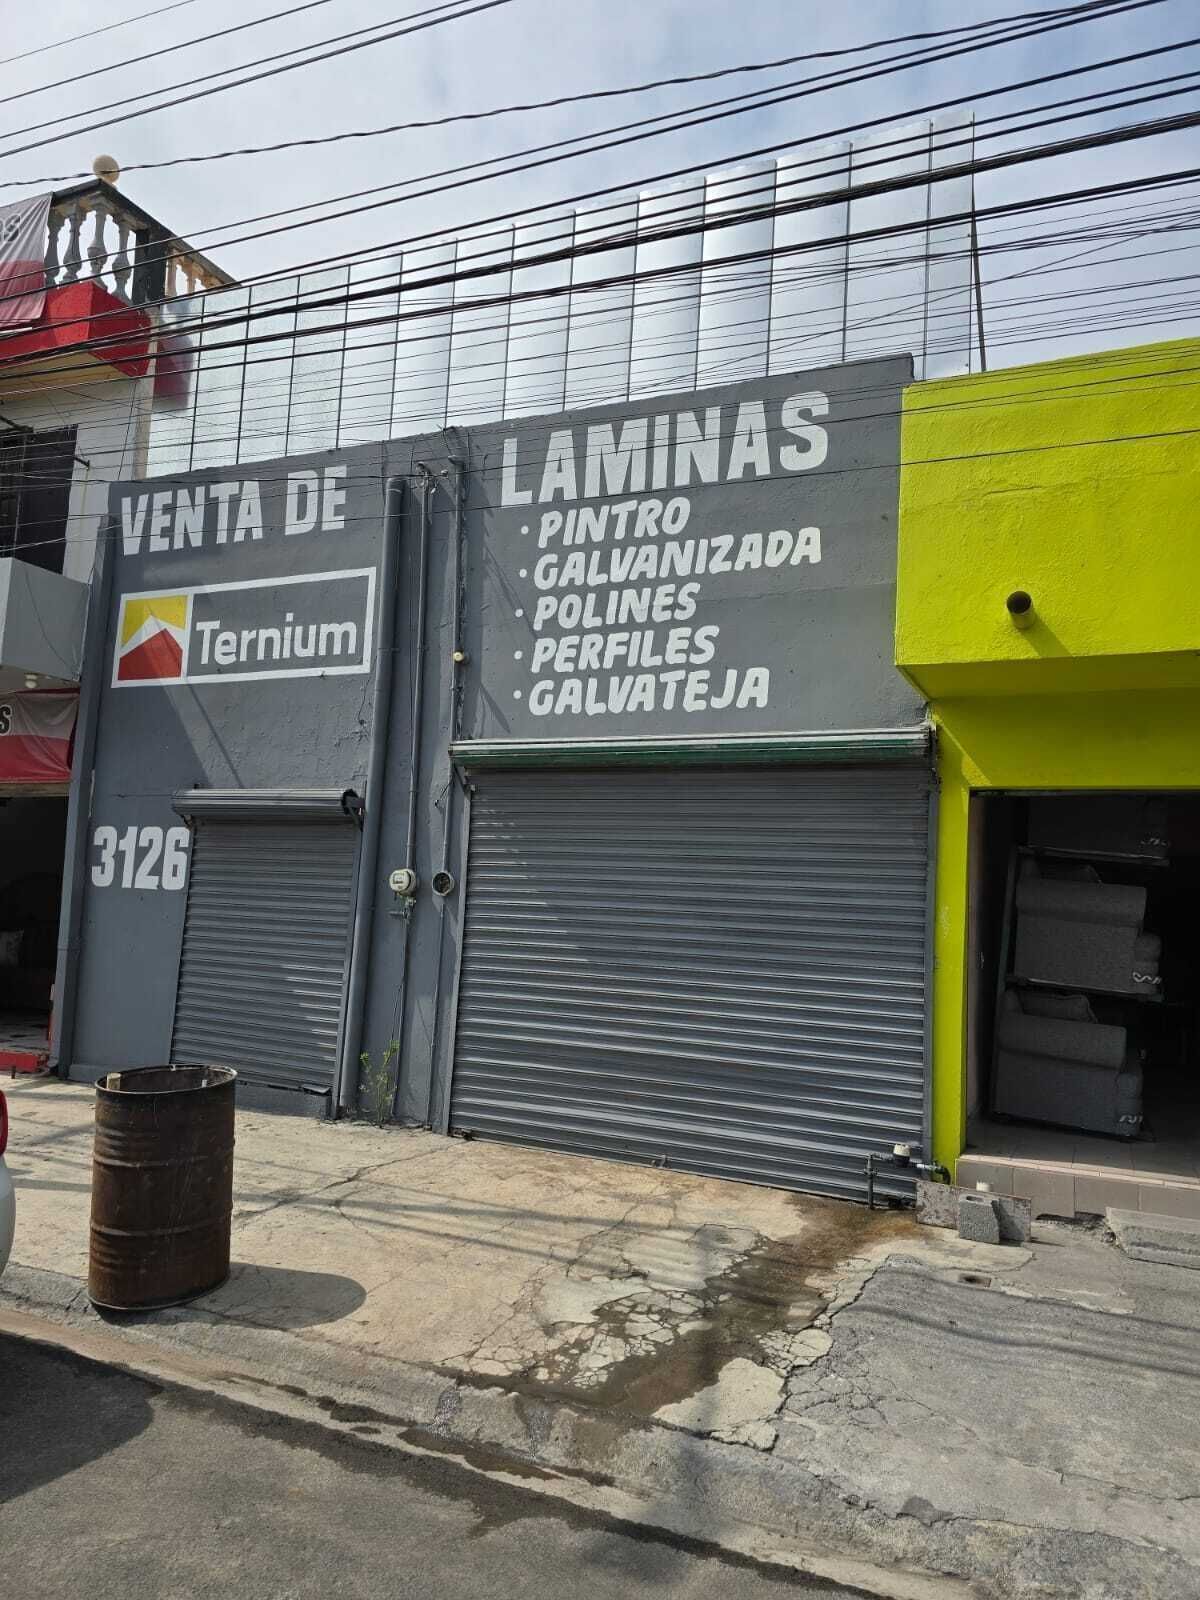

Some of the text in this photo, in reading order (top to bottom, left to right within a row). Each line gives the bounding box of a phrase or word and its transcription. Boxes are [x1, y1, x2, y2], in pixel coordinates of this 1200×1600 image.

[501, 391, 829, 508] LAMINAS
[121, 466, 347, 556] VENTA DE
[537, 497, 691, 549] PINTRO
[533, 527, 822, 590] GALVANIZADA
[533, 582, 700, 631] POLINES
[196, 612, 357, 666] Ternium
[531, 625, 720, 673] PERFILES
[528, 667, 770, 716] GALVATEJA
[91, 826, 190, 890] 3126
